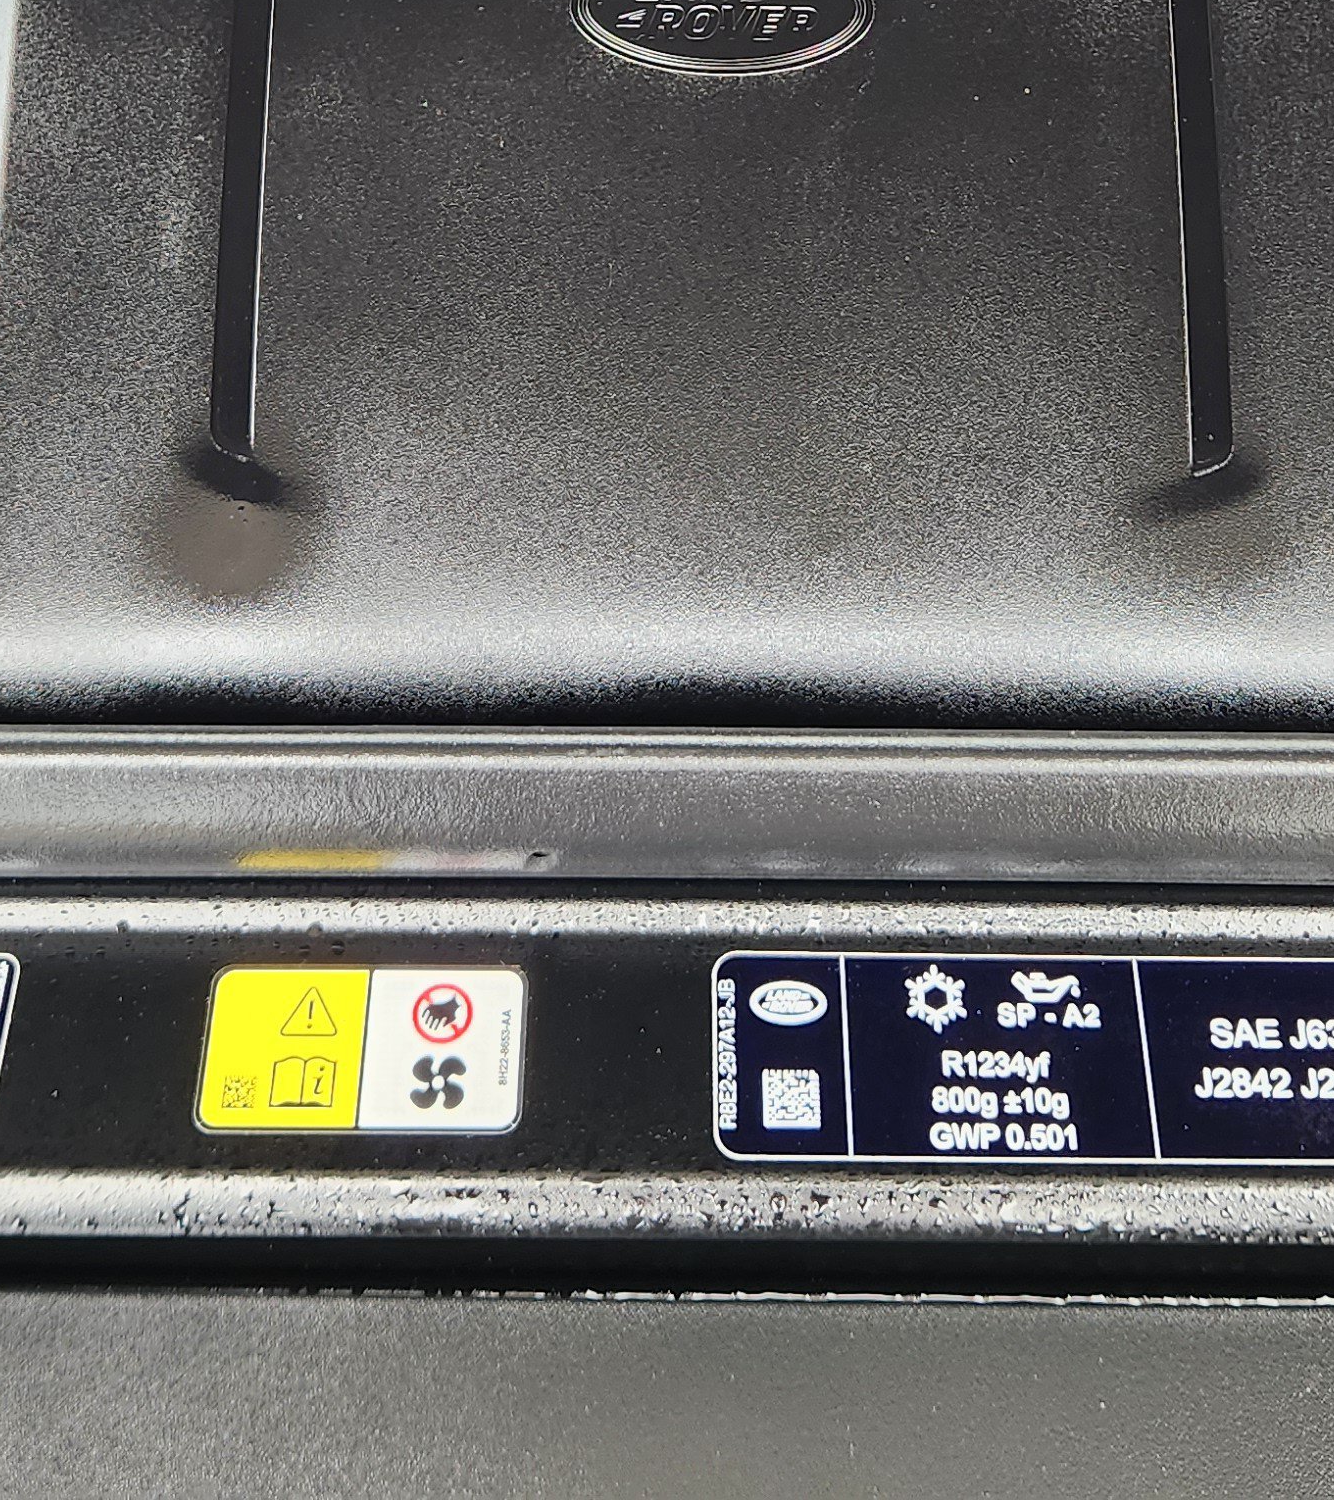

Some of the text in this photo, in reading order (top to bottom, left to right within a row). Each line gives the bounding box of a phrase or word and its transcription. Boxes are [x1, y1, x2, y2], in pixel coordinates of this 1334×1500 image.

[640, 4, 818, 41] ROVER
[1209, 1017, 1281, 1052] SAE
[718, 978, 738, 1131] R8E2-297A12-JB
[941, 1050, 1052, 1083] R1234yf
[1194, 1067, 1295, 1101] J2842
[931, 1086, 1070, 1119] 800g ±10g
[929, 1123, 1078, 1152] GWP 0.501
